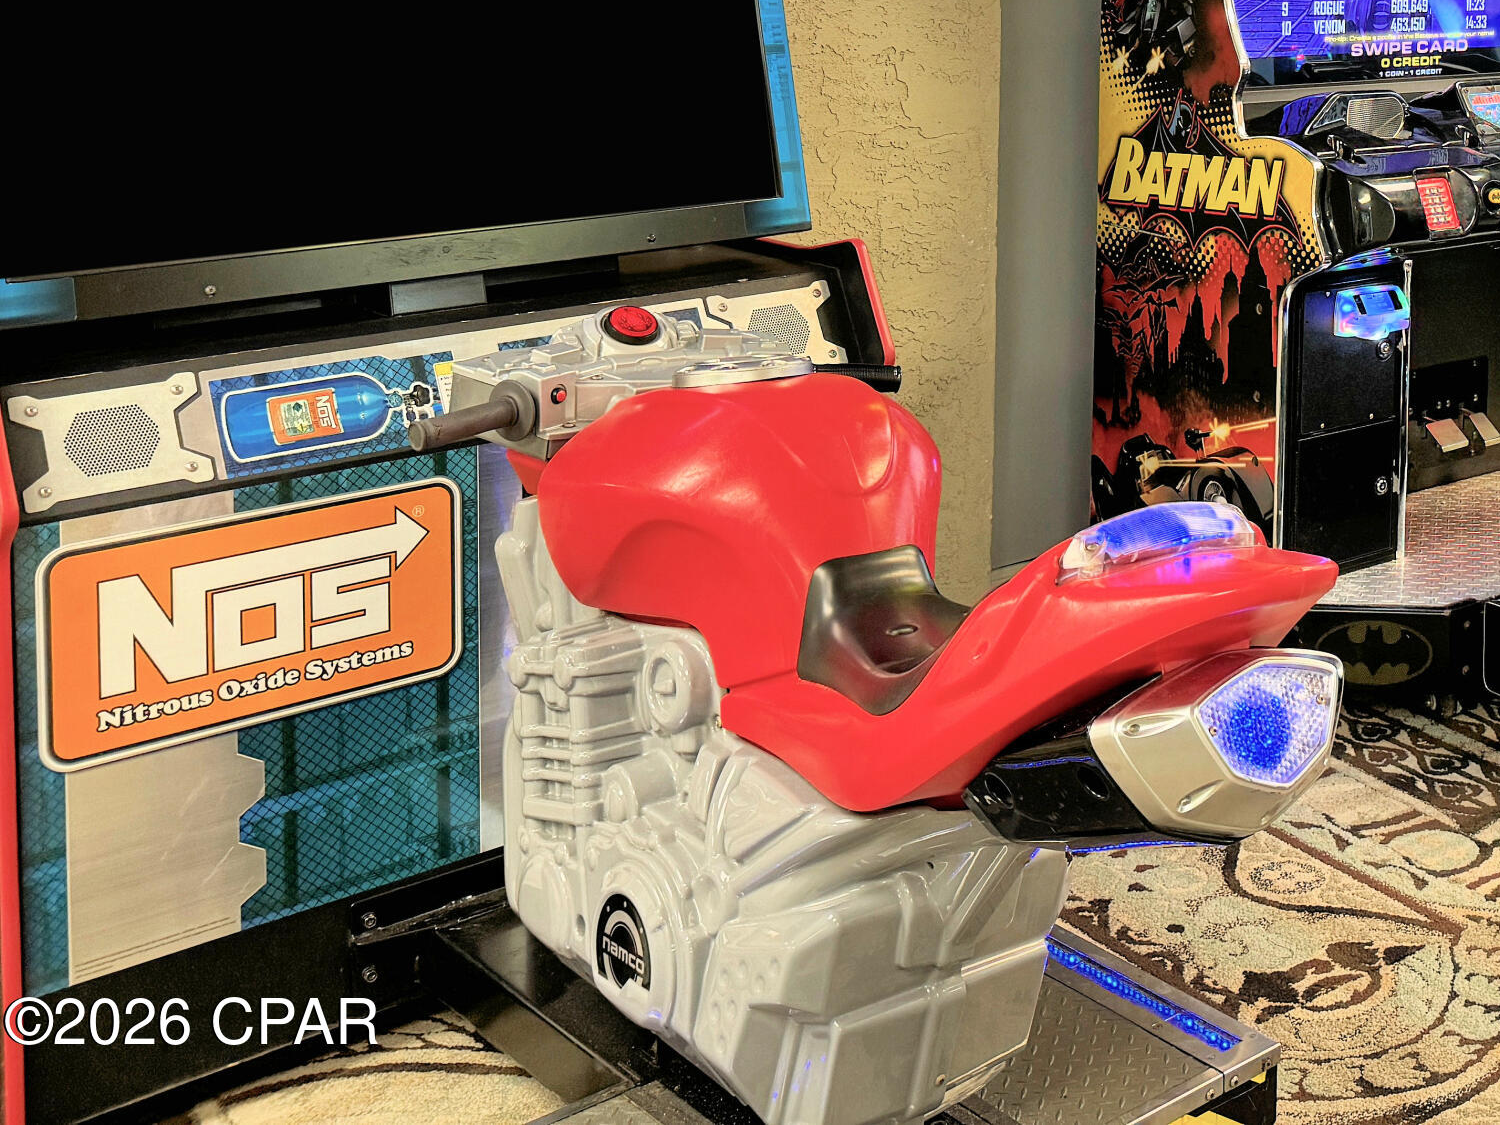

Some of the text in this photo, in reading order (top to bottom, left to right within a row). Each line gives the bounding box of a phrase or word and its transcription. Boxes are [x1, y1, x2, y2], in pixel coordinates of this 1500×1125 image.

[1281, 1, 1289, 17] 9
[1313, 0, 1345, 16] ROGUE
[1390, 0, 1428, 15] 609,649
[1281, 20, 1292, 36] 10
[1313, 19, 1346, 35] VENOM
[1390, 17, 1426, 33] 463,150
[1465, 15, 1487, 29] 14:33
[1350, 38, 1469, 58] SWIPE CARD
[1380, 55, 1442, 68] 0 CREDIT
[1415, 68, 1443, 76] CREDIT
[1107, 137, 1284, 218] BATMAN
[315, 395, 337, 429] NOS
[97, 525, 412, 699] NOS
[96, 640, 414, 733] Nitrous Oxide Systems
[602, 934, 645, 975] namco
